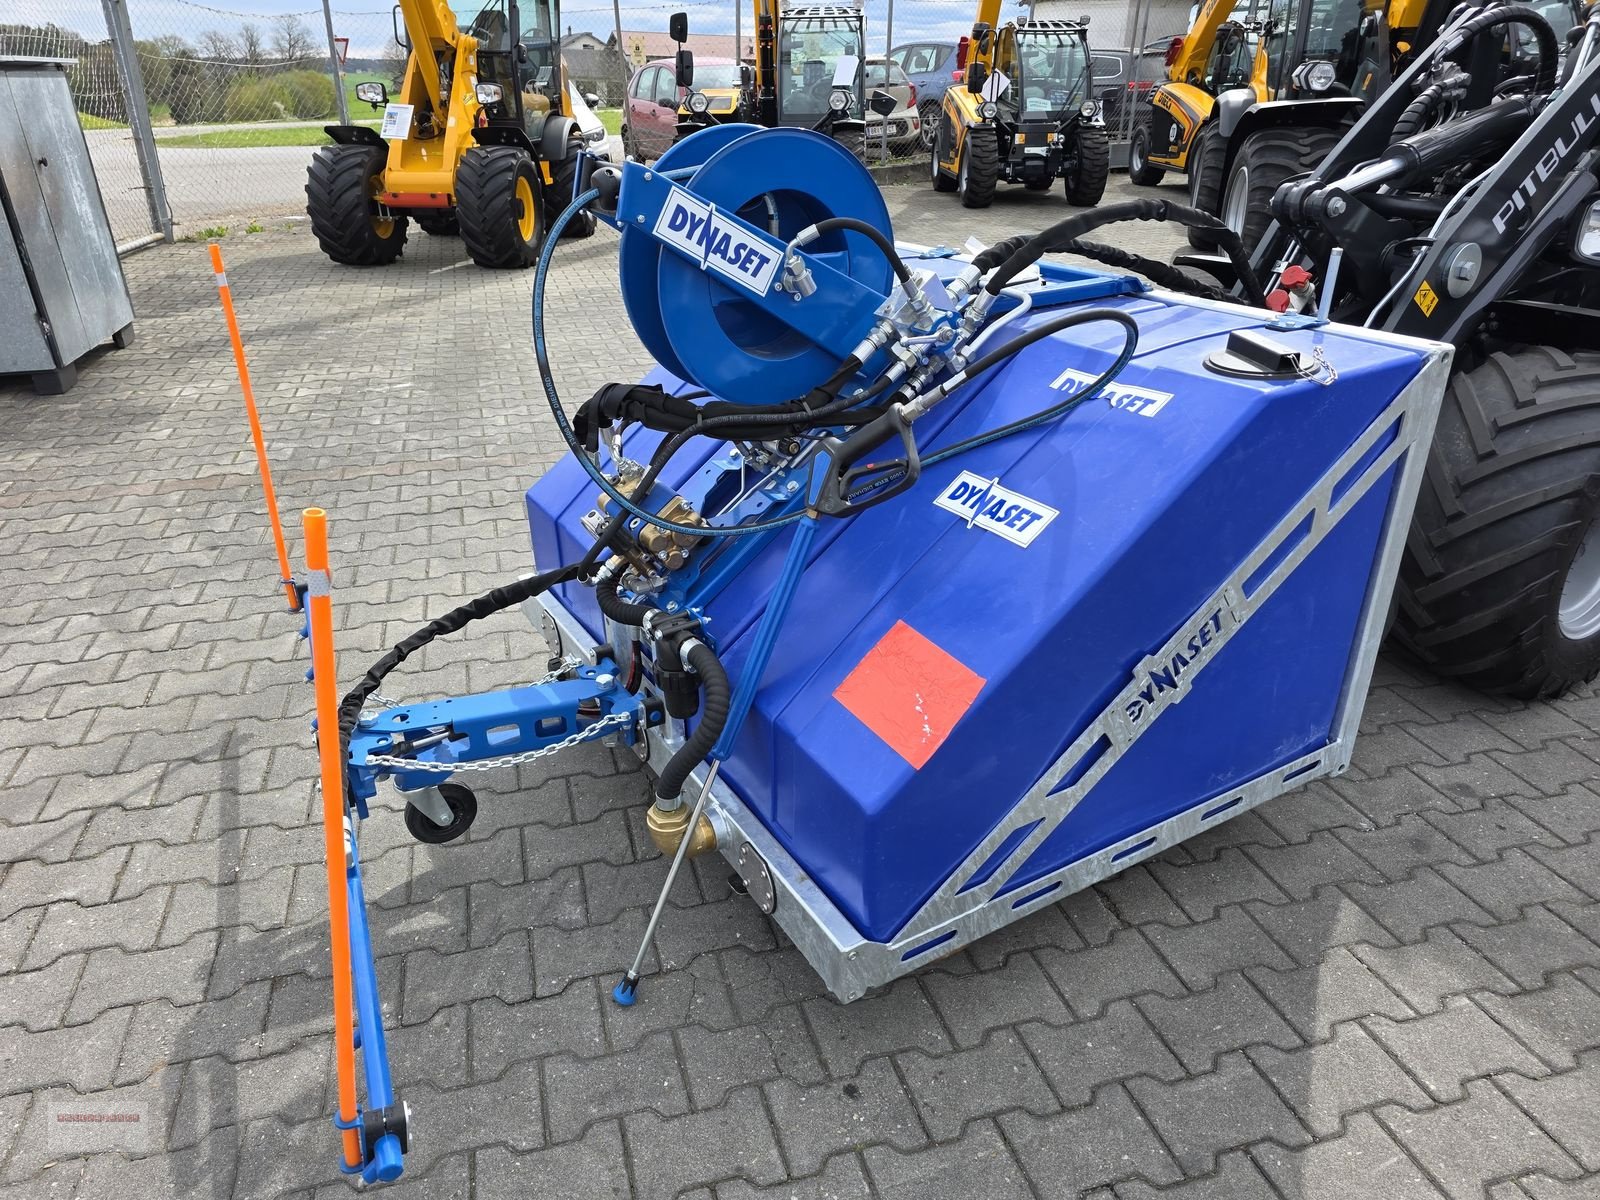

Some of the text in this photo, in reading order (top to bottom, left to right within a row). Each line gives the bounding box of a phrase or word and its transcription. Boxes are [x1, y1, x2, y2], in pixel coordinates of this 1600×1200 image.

[668, 204, 771, 278] DYNASET
[544, 376, 560, 409] DIEHARD
[1057, 378, 1158, 414] DYASET
[947, 480, 1043, 532] DYNASET
[1125, 607, 1222, 722] DYNASET
